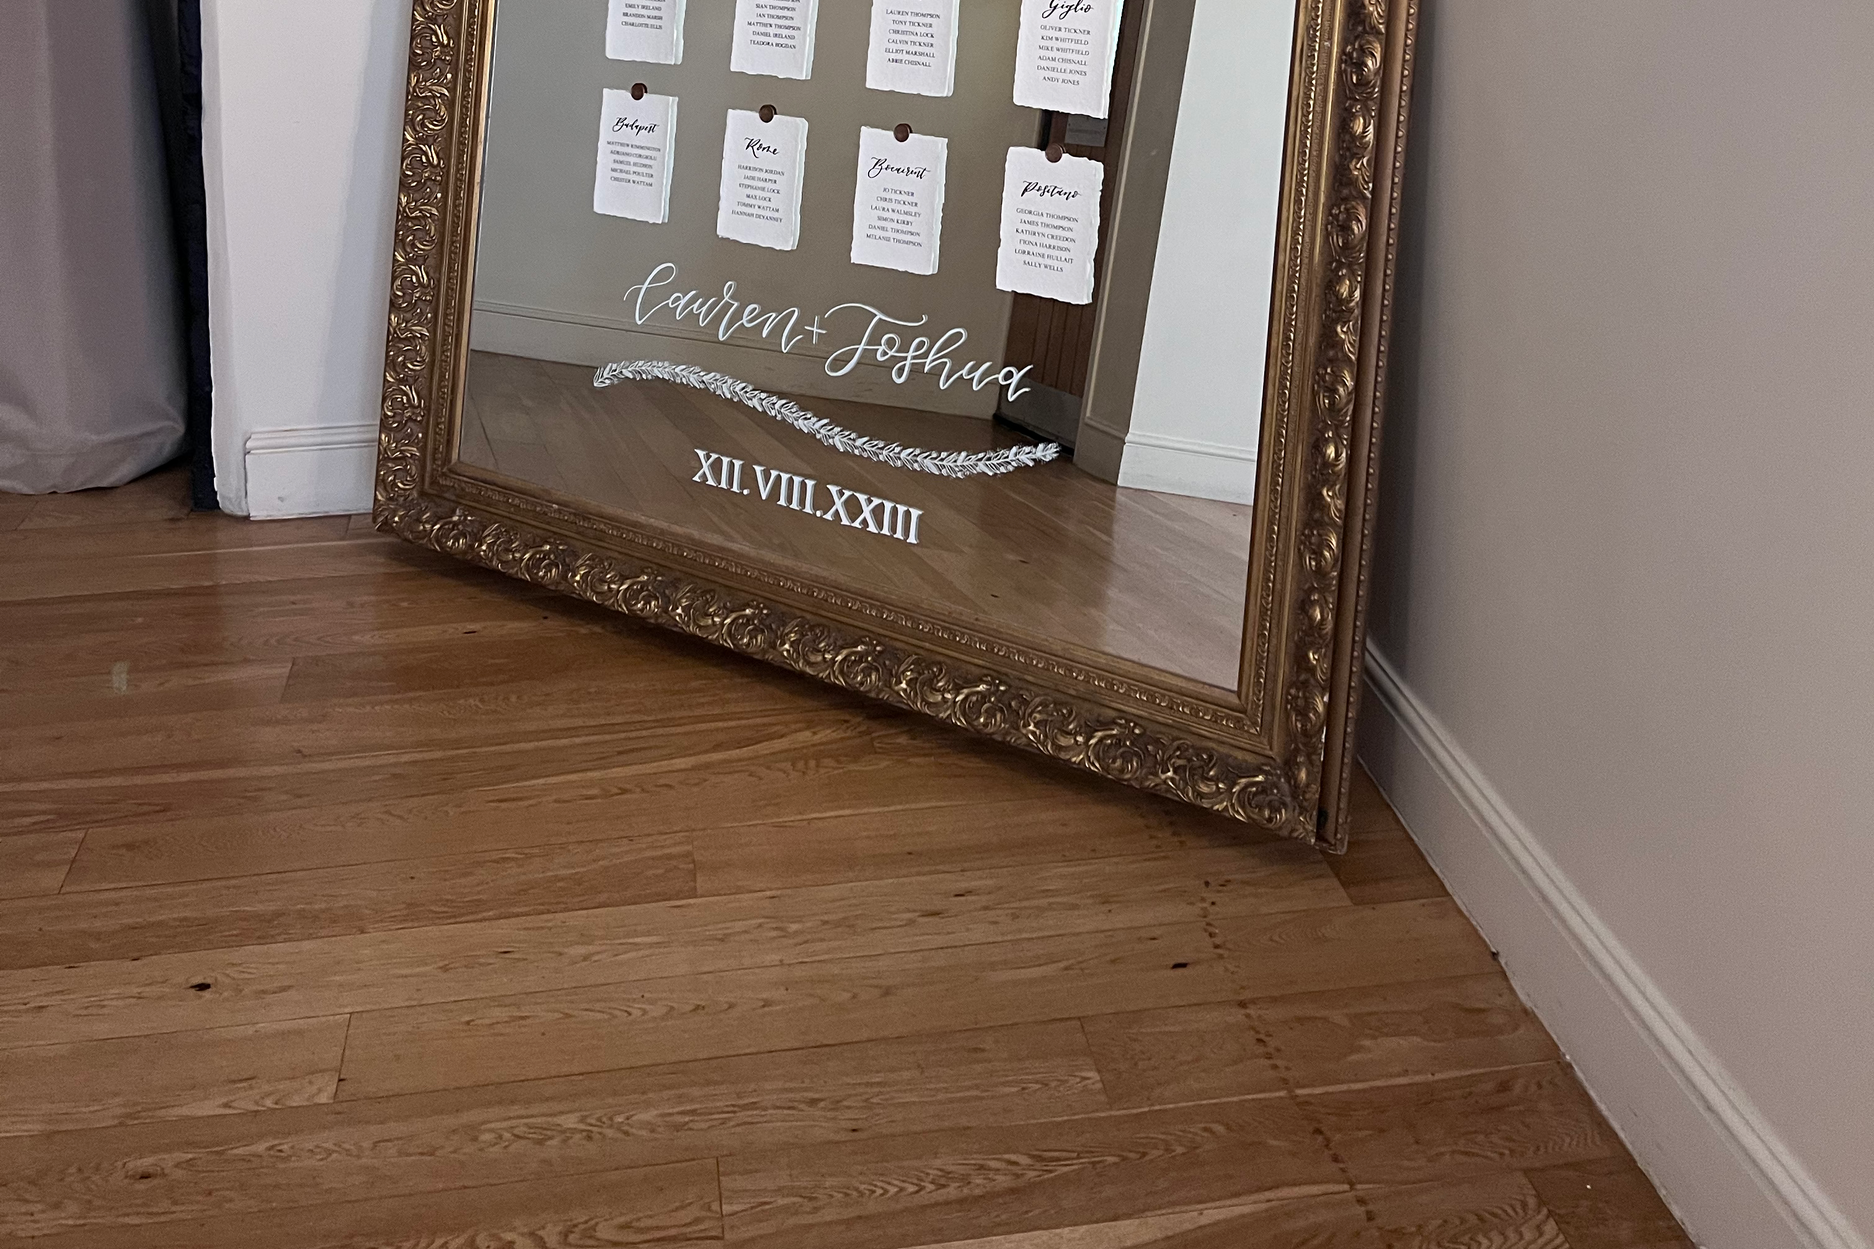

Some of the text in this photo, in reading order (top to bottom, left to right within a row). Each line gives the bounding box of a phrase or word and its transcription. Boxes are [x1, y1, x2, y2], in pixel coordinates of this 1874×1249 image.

[888, 29, 918, 37] CHRISTINA
[1054, 37, 1088, 45] WHITFIELD
[905, 50, 935, 58] MARSHALL
[1056, 48, 1090, 56] WHITFIELD
[1058, 58, 1087, 66] CHISNALL
[1037, 65, 1068, 74] DANIELLE
[1061, 78, 1080, 86] JONES
[612, 117, 659, 136] Budapest
[744, 136, 780, 159] Rome
[611, 168, 632, 176] MICHAEL
[738, 164, 785, 176] HARRISON JORDAN
[739, 183, 766, 192] STEPHANIE
[890, 188, 915, 197] TICKNER
[1021, 180, 1082, 201] Positano
[737, 201, 780, 213] TOMMY WATTAM
[894, 198, 918, 207] TICKNER
[732, 210, 754, 218] HANNAH
[871, 205, 922, 218] LAURA WALMSLEY
[1016, 208, 1079, 223] GEORGIA THOMPSON
[869, 224, 921, 237] DANIEL THOMPSON
[1020, 219, 1074, 232] JAMES THOMPSON
[866, 233, 923, 247] MELANIE THOMPSON
[1015, 228, 1076, 244] KATHRYN CREEDON
[1019, 239, 1071, 253] FIONA HARRISON
[1014, 248, 1046, 259] LORRAINE
[1023, 260, 1064, 272] SALLY WELLS
[824, 303, 1034, 402] Joshua
[692, 448, 924, 545] XII.VIII.XXIII
